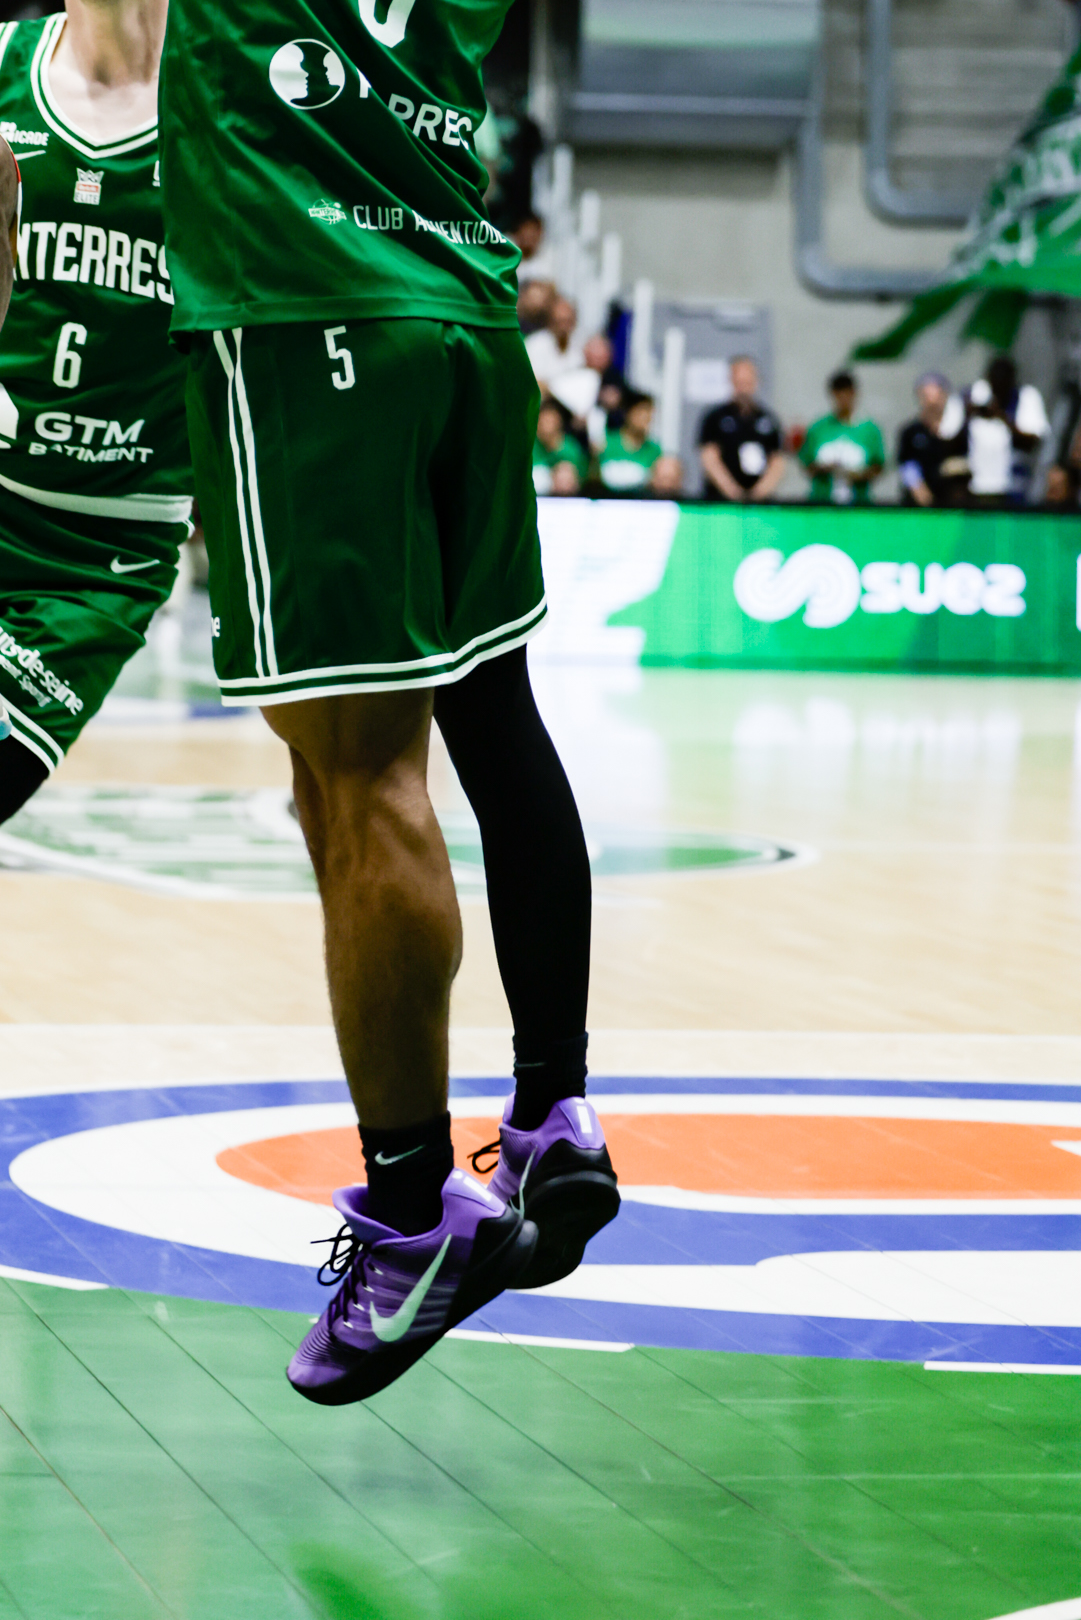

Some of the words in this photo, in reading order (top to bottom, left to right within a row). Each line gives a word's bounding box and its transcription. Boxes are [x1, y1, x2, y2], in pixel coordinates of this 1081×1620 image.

[352, 205, 404, 231] CLUB
[52, 321, 88, 389] 6
[323, 324, 356, 391] 5
[34, 411, 146, 446] GTM
[859, 561, 1027, 617] suez
